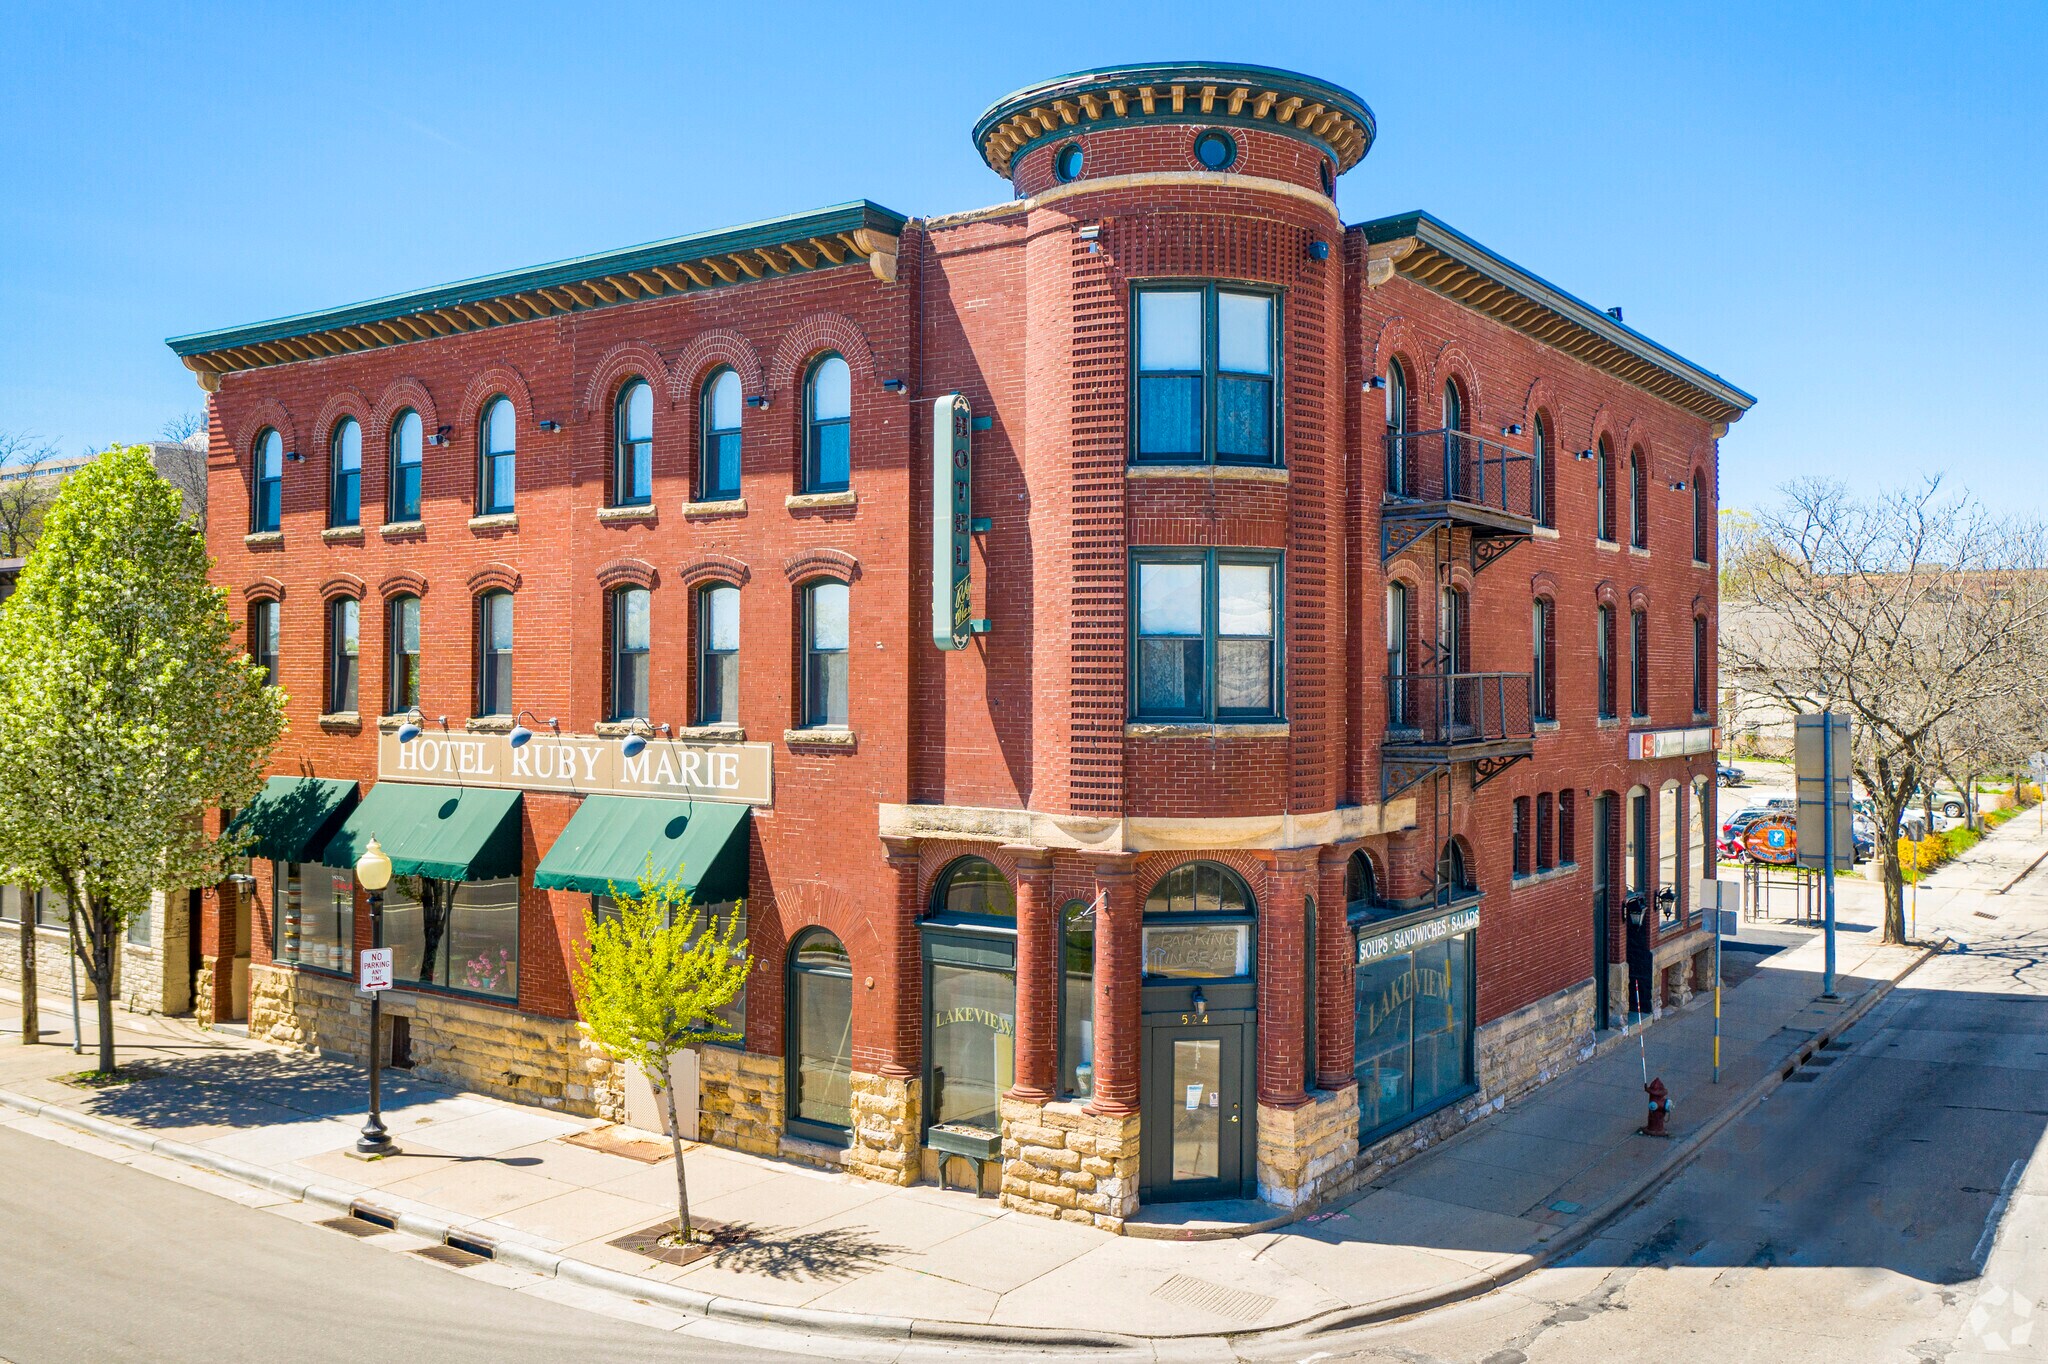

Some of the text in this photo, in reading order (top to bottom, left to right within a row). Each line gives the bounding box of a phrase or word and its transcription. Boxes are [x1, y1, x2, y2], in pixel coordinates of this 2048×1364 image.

[954, 416, 969, 567] HOTEL
[397, 738, 740, 790] HOTEL RUBY MARIE
[1160, 931, 1236, 949] PARKING
[1360, 910, 1479, 960] SOUPS SANDWICHES SALADS
[363, 960, 391, 970] PARKING
[371, 952, 383, 961] NO
[1165, 948, 1236, 965] IN REAR
[1369, 968, 1450, 1035] LAKEVIEW
[936, 1006, 1013, 1036] LAKEVIEW
[1181, 1014, 1209, 1025] 524
